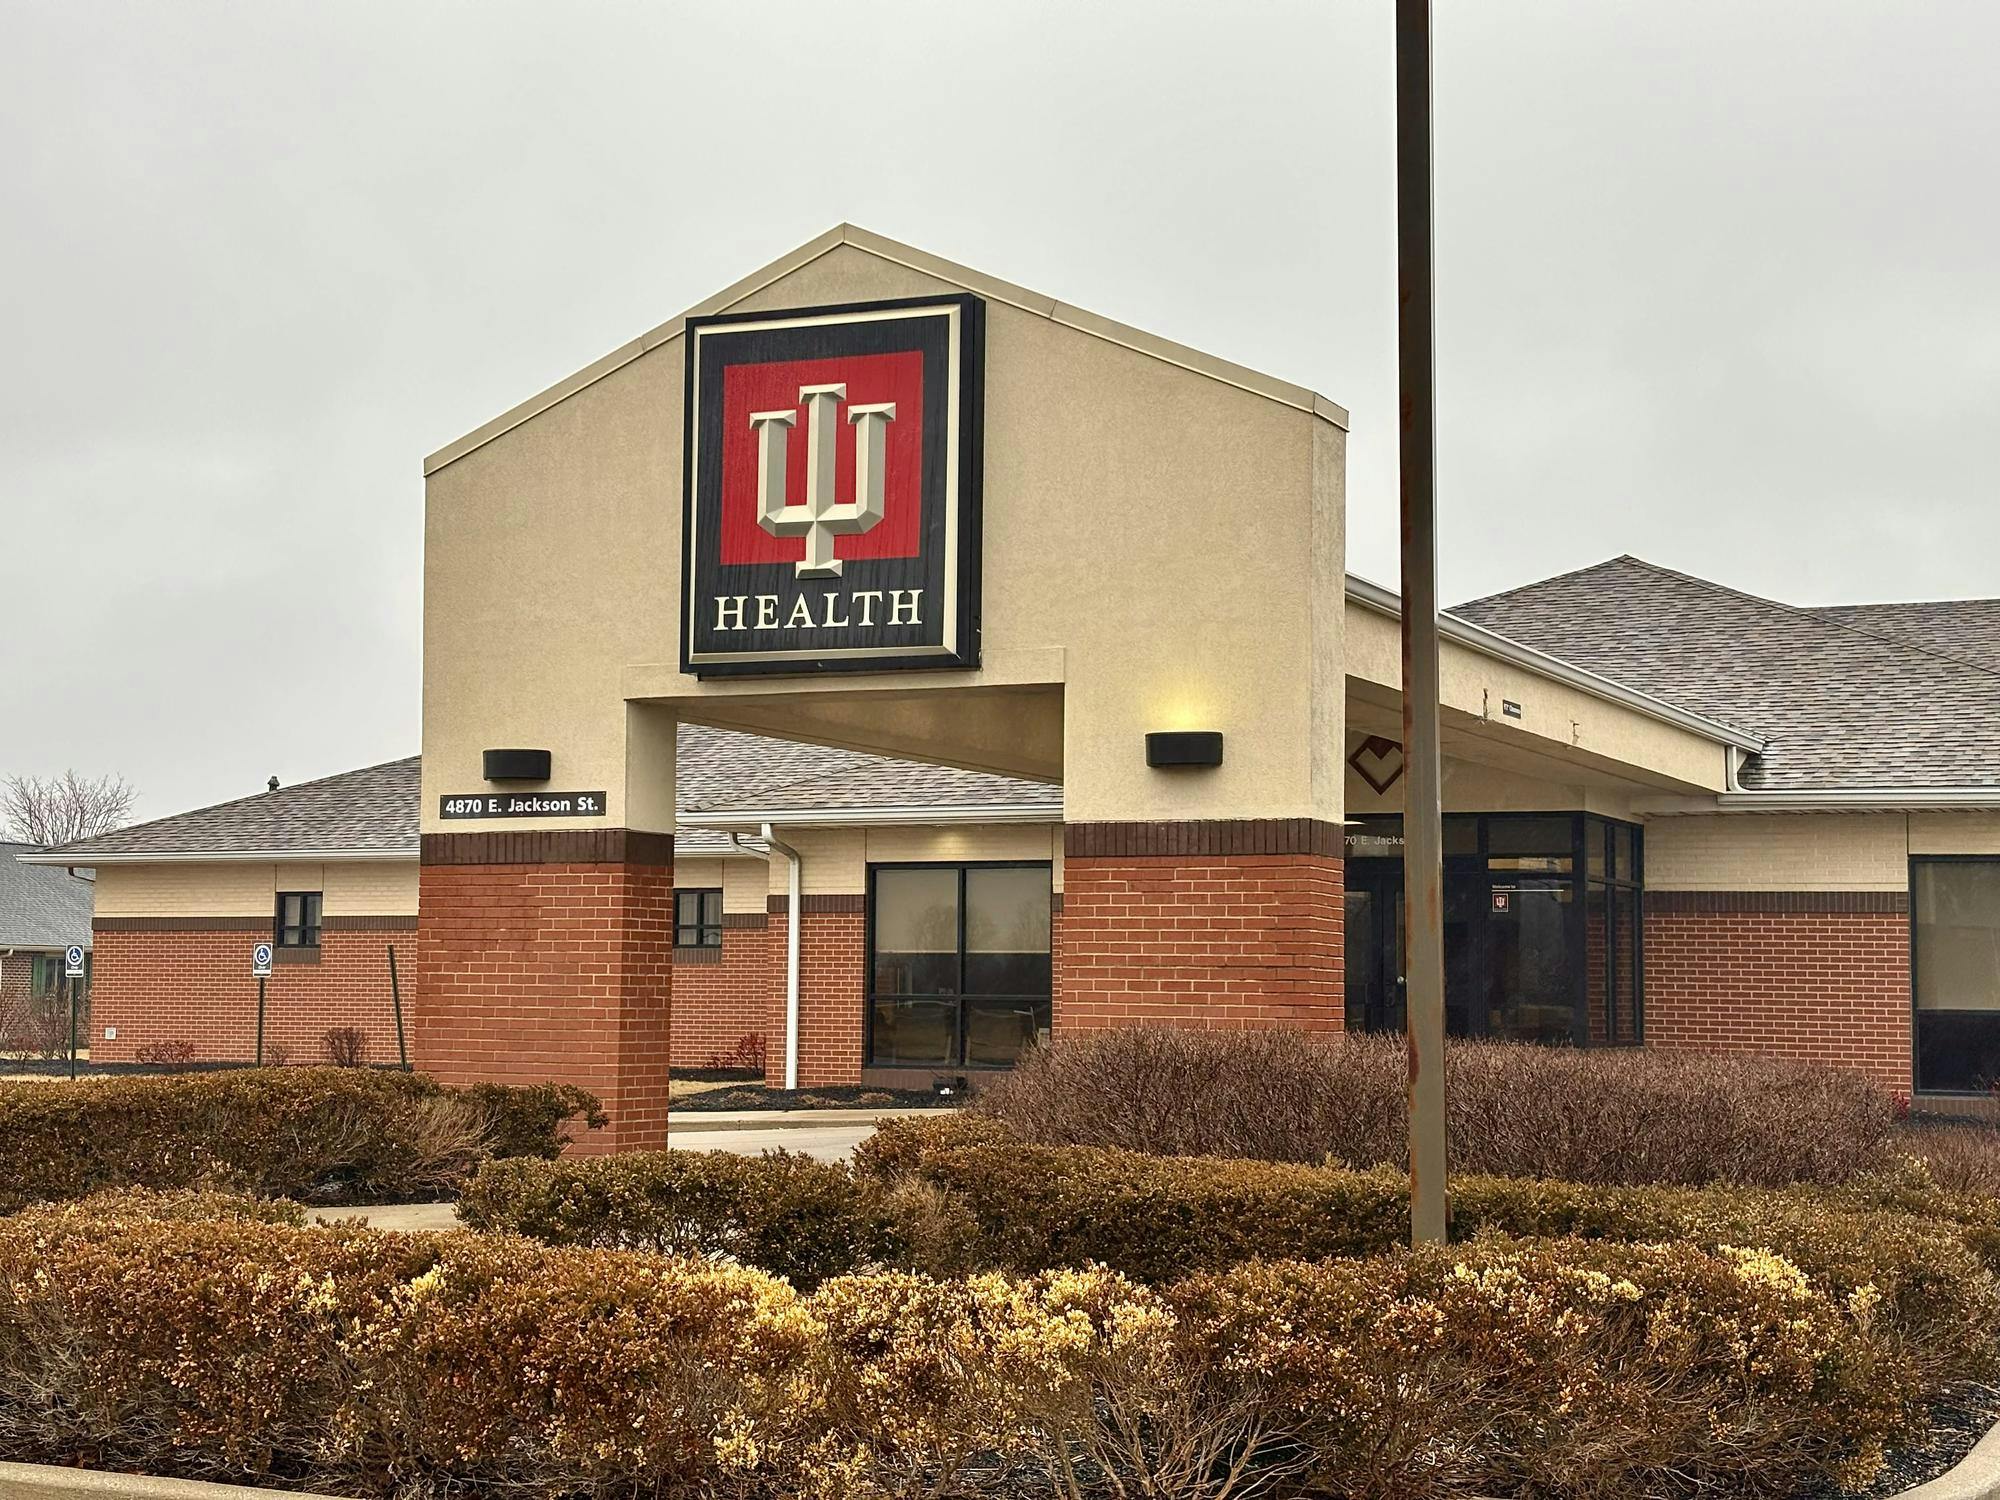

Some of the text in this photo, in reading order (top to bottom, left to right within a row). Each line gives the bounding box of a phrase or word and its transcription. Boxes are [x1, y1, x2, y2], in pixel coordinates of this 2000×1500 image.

[713, 588, 925, 632] HEALTH
[445, 796, 599, 813] 4870 E. Jackson St.
[1344, 835, 1357, 845] 70
[1374, 835, 1404, 845] Jacks
